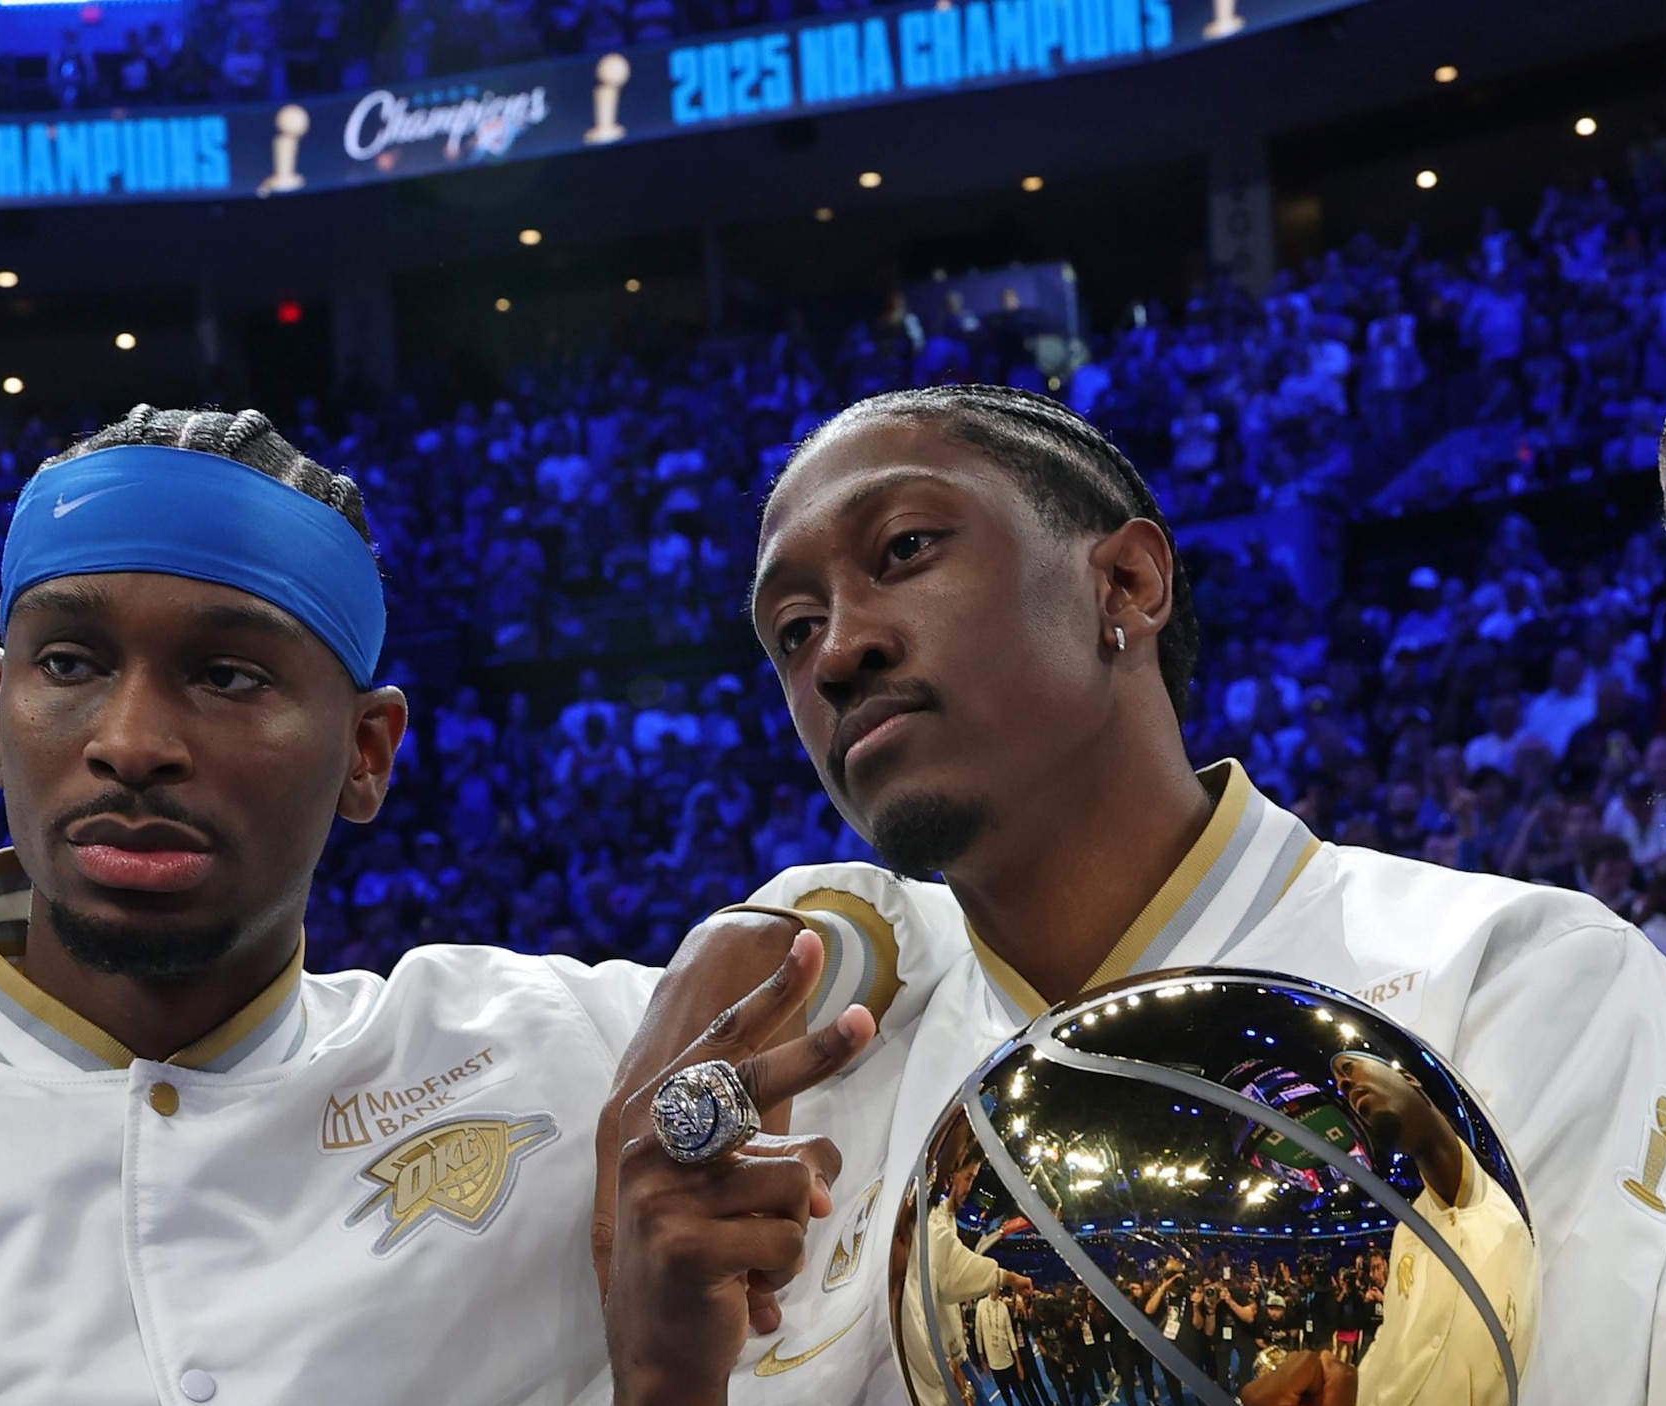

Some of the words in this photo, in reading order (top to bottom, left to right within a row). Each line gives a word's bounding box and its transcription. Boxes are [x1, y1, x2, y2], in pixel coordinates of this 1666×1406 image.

[669, 33, 793, 126] 2025
[799, 17, 896, 105] NBA
[899, 0, 1173, 89] CHAMPIONS
[343, 86, 550, 160] Champions
[375, 1091, 456, 1137] BANK
[393, 1126, 481, 1214] OKC
